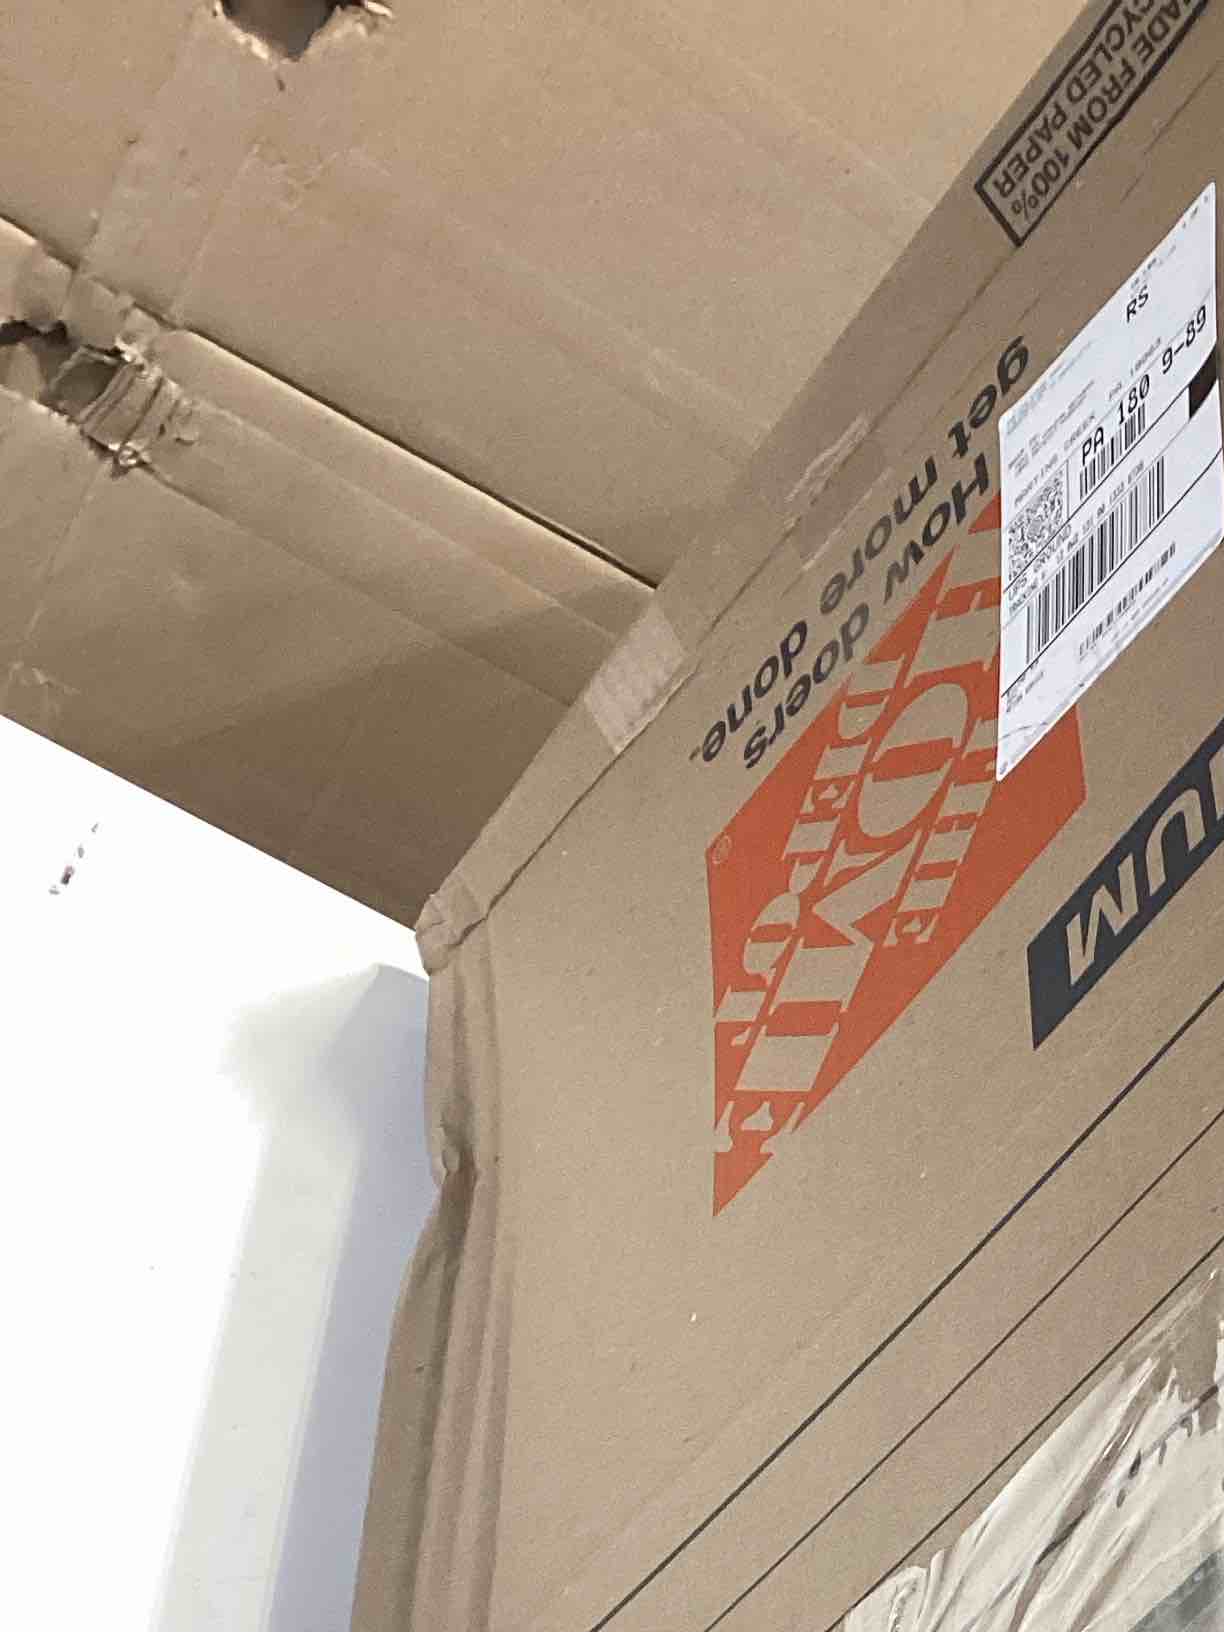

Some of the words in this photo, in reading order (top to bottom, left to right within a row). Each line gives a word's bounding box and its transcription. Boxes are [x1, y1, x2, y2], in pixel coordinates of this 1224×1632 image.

[1066, 0, 1155, 104] CYCLED
[1132, 0, 1192, 64] ADE
[992, 101, 1068, 198] PAPER
[1067, 58, 1137, 150] FROM
[1011, 147, 1070, 220] 100%
[1126, 284, 1149, 323] RS
[948, 335, 1029, 460] get
[1081, 426, 1105, 466] PA
[1118, 373, 1150, 425] 180
[1162, 304, 1206, 375] 9-89
[819, 455, 938, 615] more
[884, 453, 990, 604] How
[689, 619, 808, 763] done.
[743, 602, 869, 769] doers
[711, 655, 903, 1046] DEPOT
